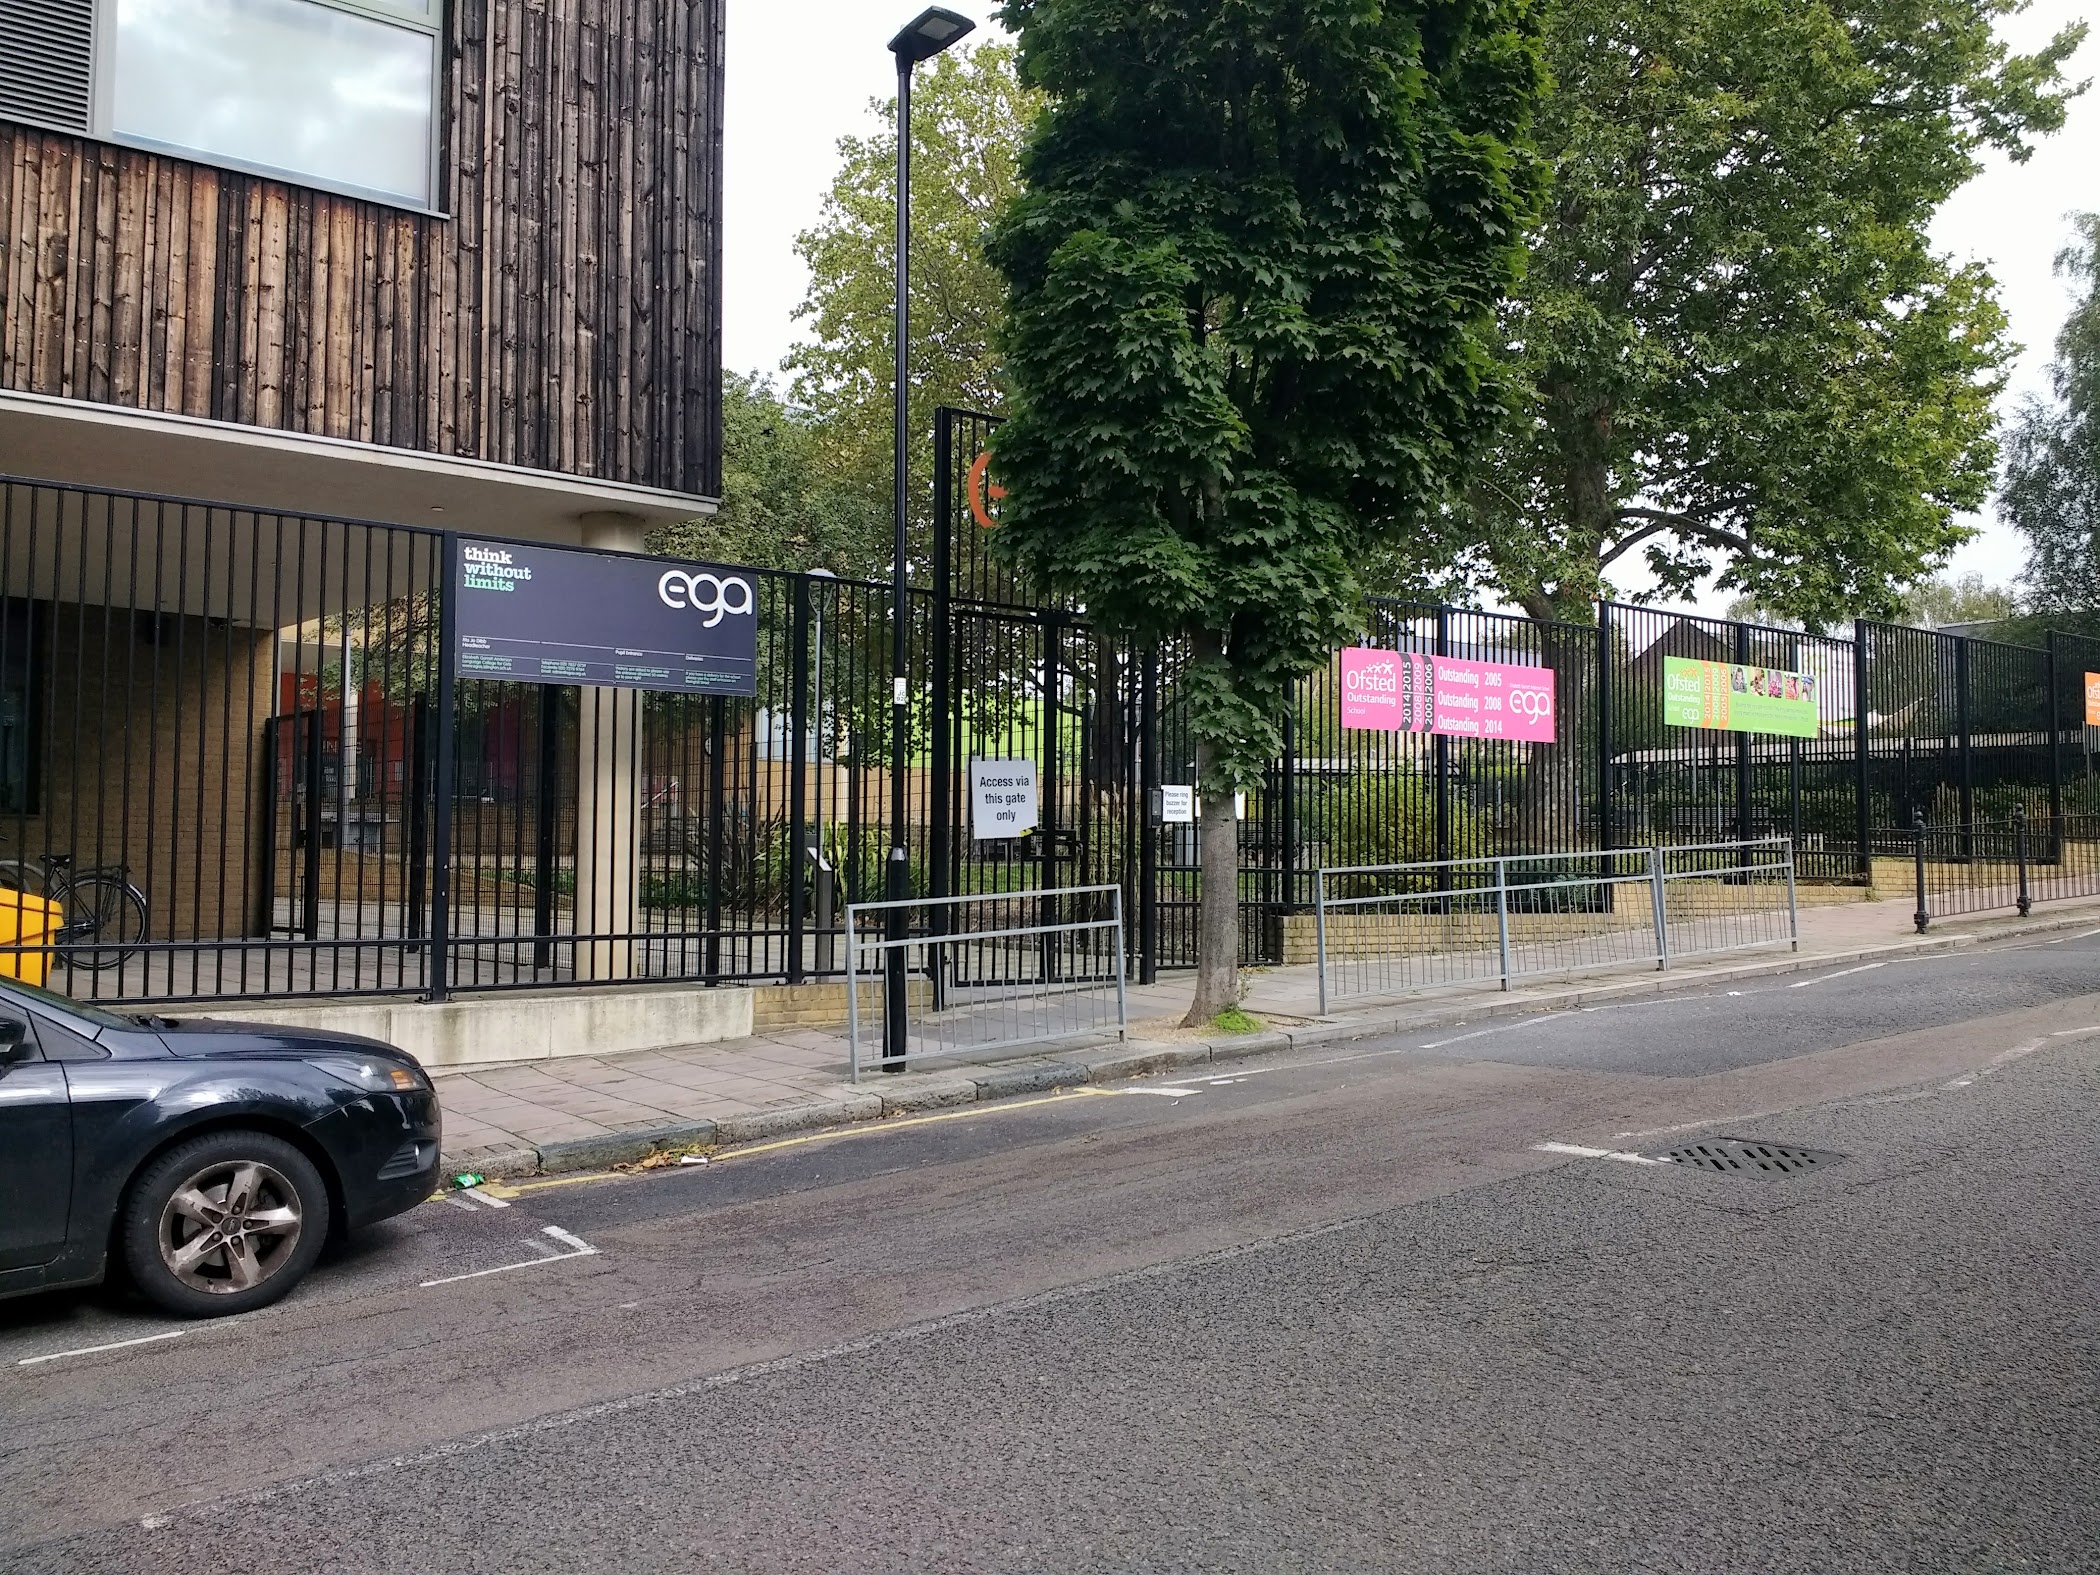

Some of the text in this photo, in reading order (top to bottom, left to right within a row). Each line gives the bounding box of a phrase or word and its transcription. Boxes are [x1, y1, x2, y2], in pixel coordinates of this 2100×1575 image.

[464, 547, 512, 564] think
[464, 562, 532, 580] without
[464, 574, 515, 591] limits
[659, 570, 753, 628] ega
[1346, 670, 1396, 692] Ofsted
[1438, 665, 1502, 689] Outstanding 2005
[1667, 673, 1700, 693] Ofsted
[1347, 692, 1396, 707] Outstanding
[1403, 661, 1411, 724] 2014 2015
[1414, 663, 1422, 724] 2008 2009
[1425, 664, 1433, 725] 2005 2006
[1437, 690, 1502, 713] Outstanding 2008
[1668, 692, 1700, 705] Outstanding
[1347, 706, 1366, 714] School
[1509, 689, 1551, 726] ega
[1682, 708, 1699, 724] ega
[1437, 714, 1503, 736] Outstanding 2014
[980, 775, 1030, 787] Access via
[985, 792, 1026, 806] this gate
[996, 809, 1016, 822] only
